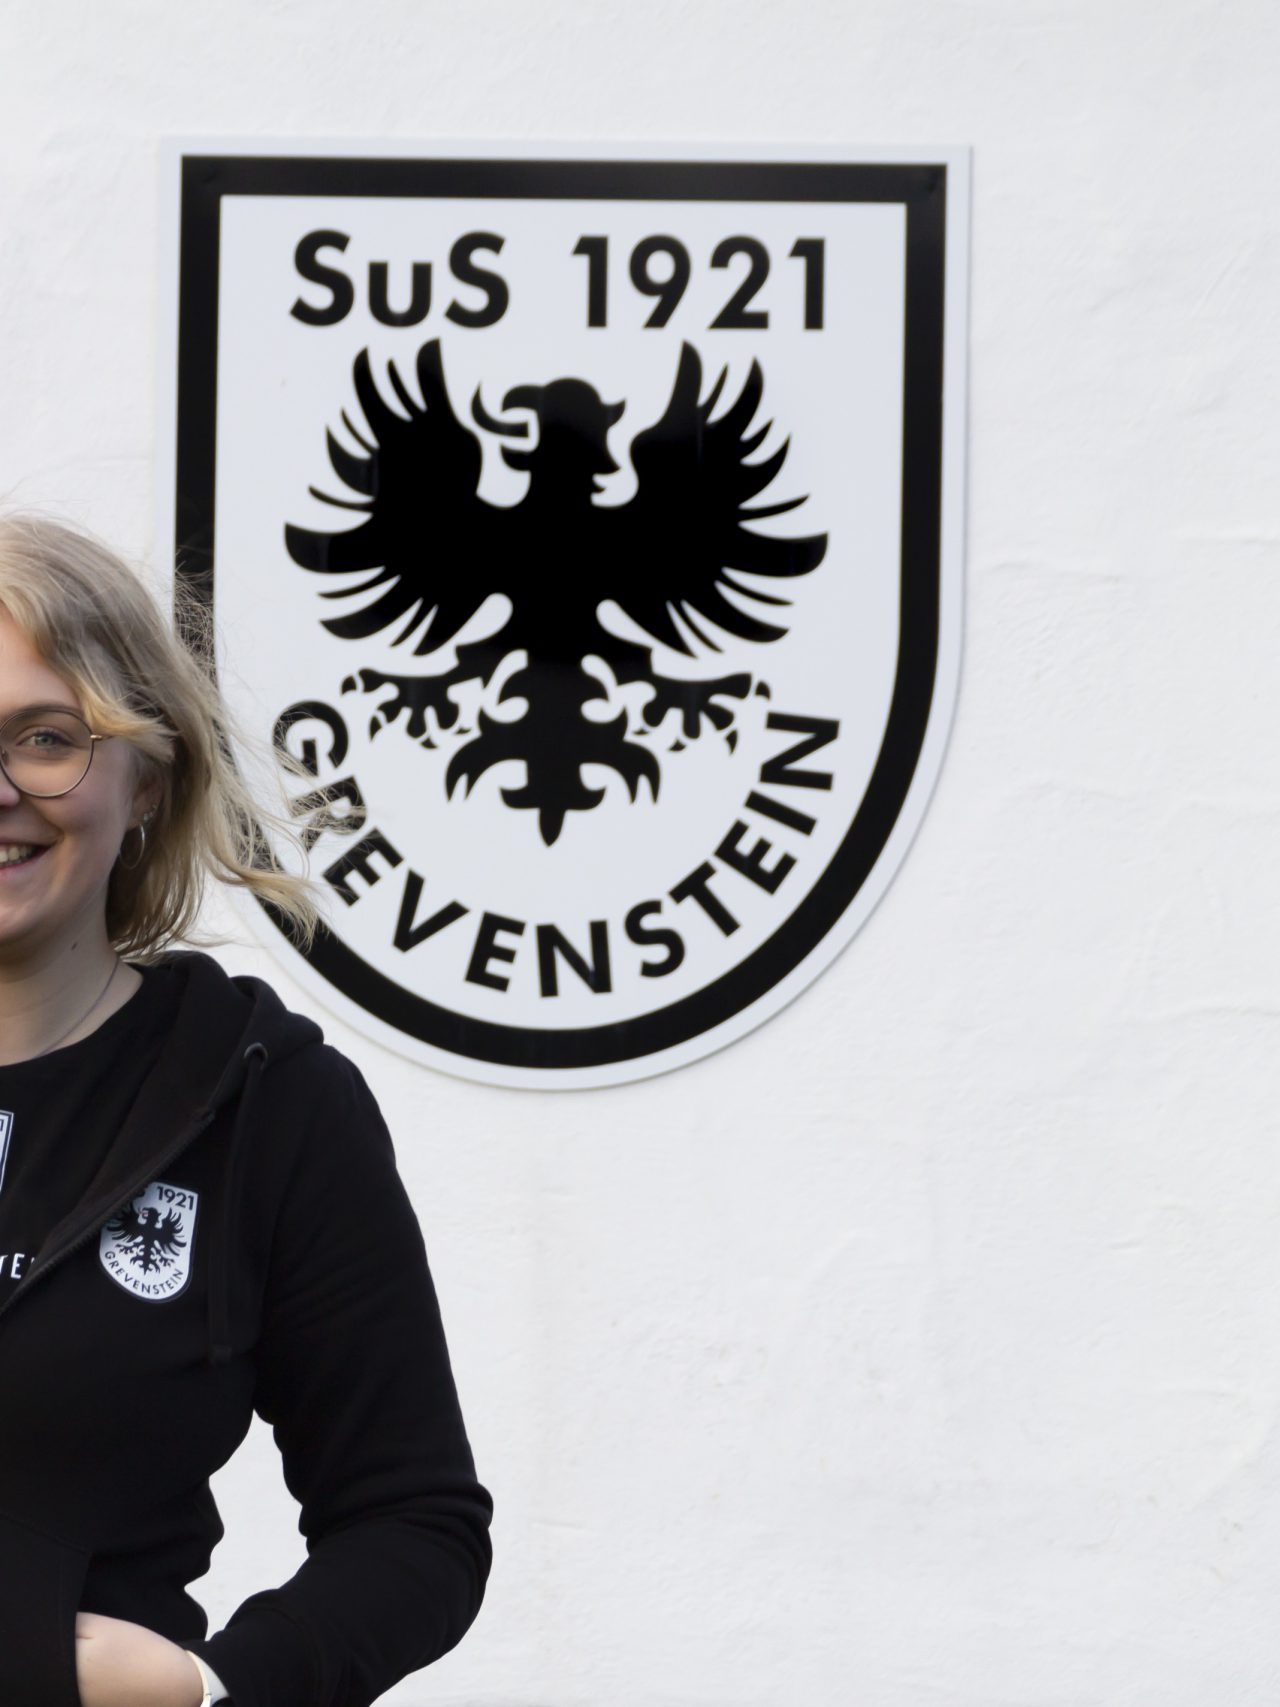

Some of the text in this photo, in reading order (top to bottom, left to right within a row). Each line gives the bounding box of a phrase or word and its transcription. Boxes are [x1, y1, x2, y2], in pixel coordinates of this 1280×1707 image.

[289, 229, 826, 331] SuS 1921
[271, 700, 841, 998] GREVENSTEIN
[157, 1186, 194, 1211] 1921
[104, 1251, 184, 1295] GREVENSTEIN
